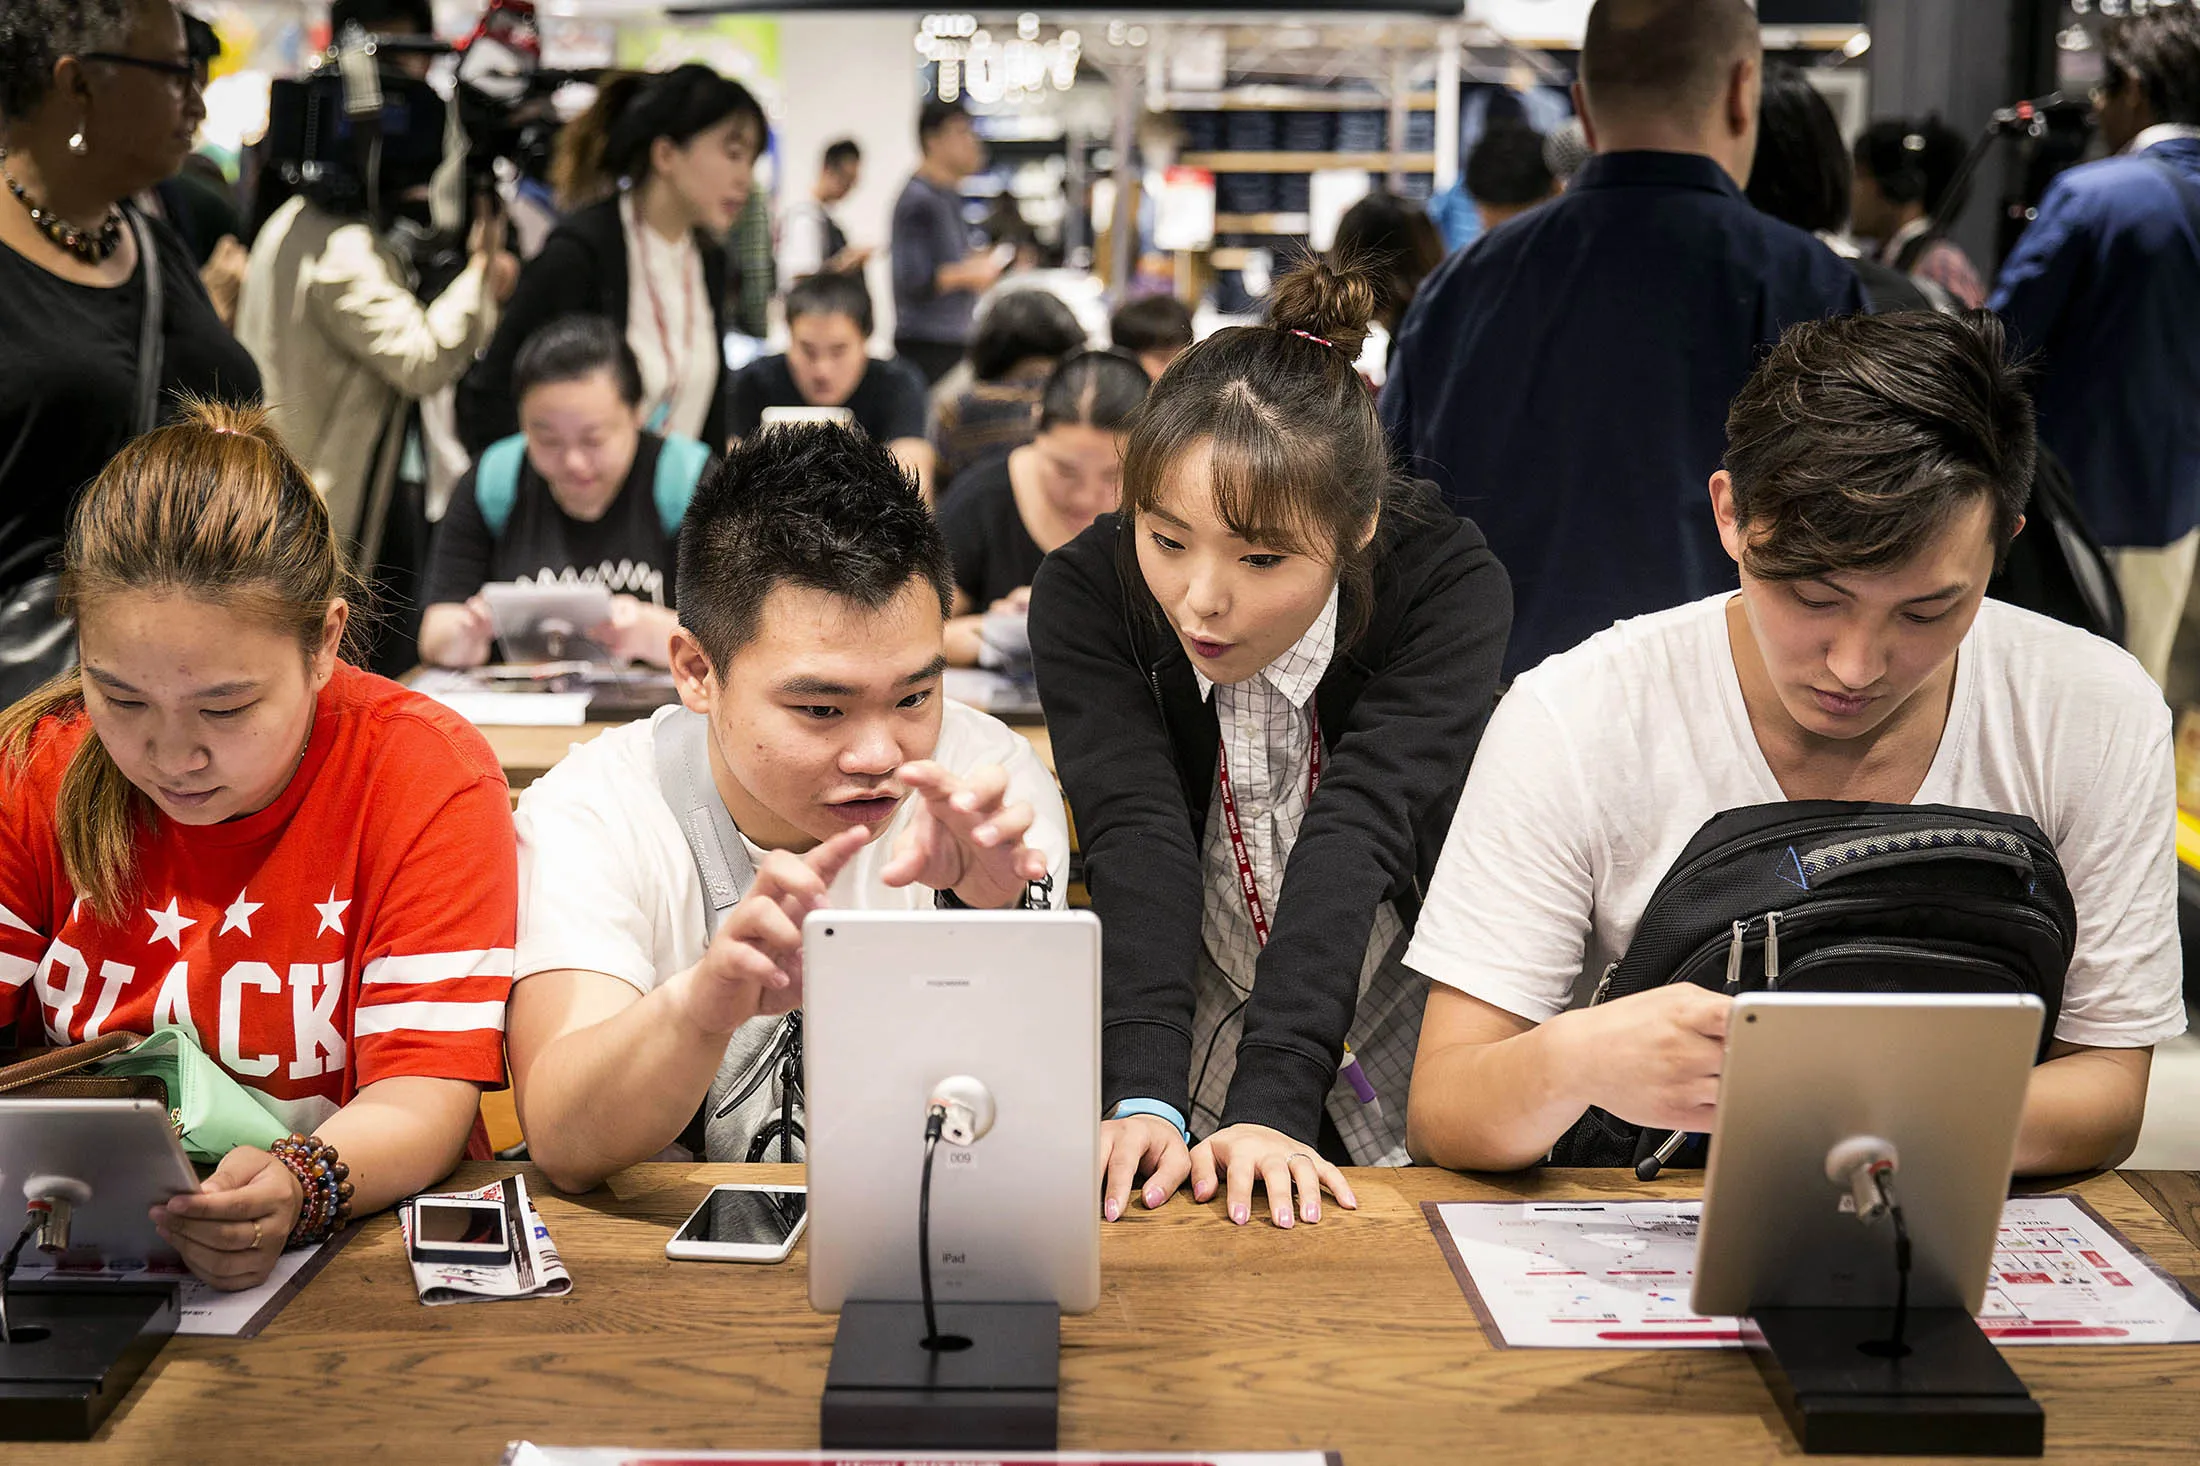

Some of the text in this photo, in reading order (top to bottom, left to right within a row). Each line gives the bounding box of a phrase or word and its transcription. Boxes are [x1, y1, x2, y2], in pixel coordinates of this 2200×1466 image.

[1227, 811, 1239, 834] UNIQLO
[1235, 841, 1247, 865] UNIQLO
[1243, 871, 1255, 895] UNIQLO
[1250, 901, 1263, 923] UNIQLO
[33, 936, 348, 1080] BLACK
[941, 1251, 966, 1265] iPad
